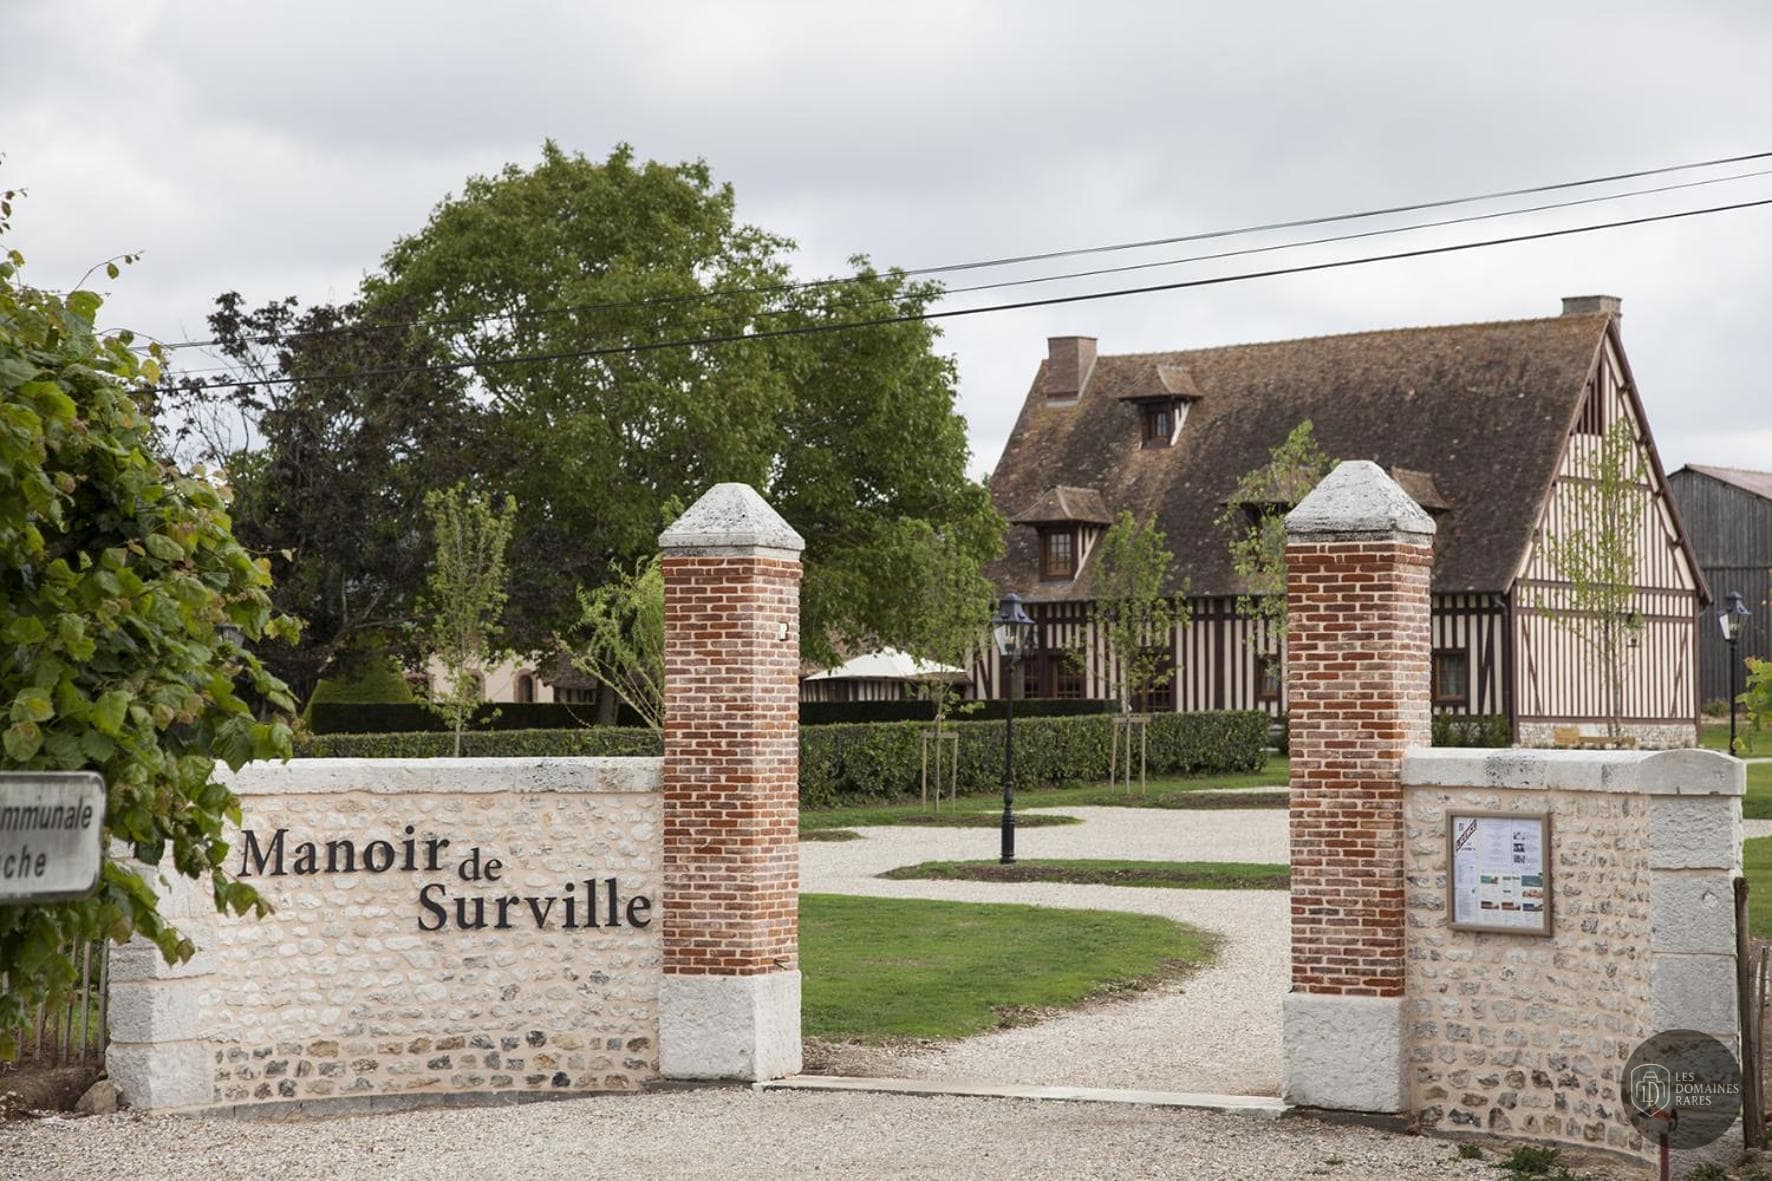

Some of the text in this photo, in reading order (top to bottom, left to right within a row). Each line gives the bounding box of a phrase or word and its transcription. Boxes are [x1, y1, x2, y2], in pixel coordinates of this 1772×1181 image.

[0, 797, 93, 830] mmunale
[0, 845, 46, 879] che
[237, 825, 503, 881] Manoir de
[418, 877, 652, 930] Surville
